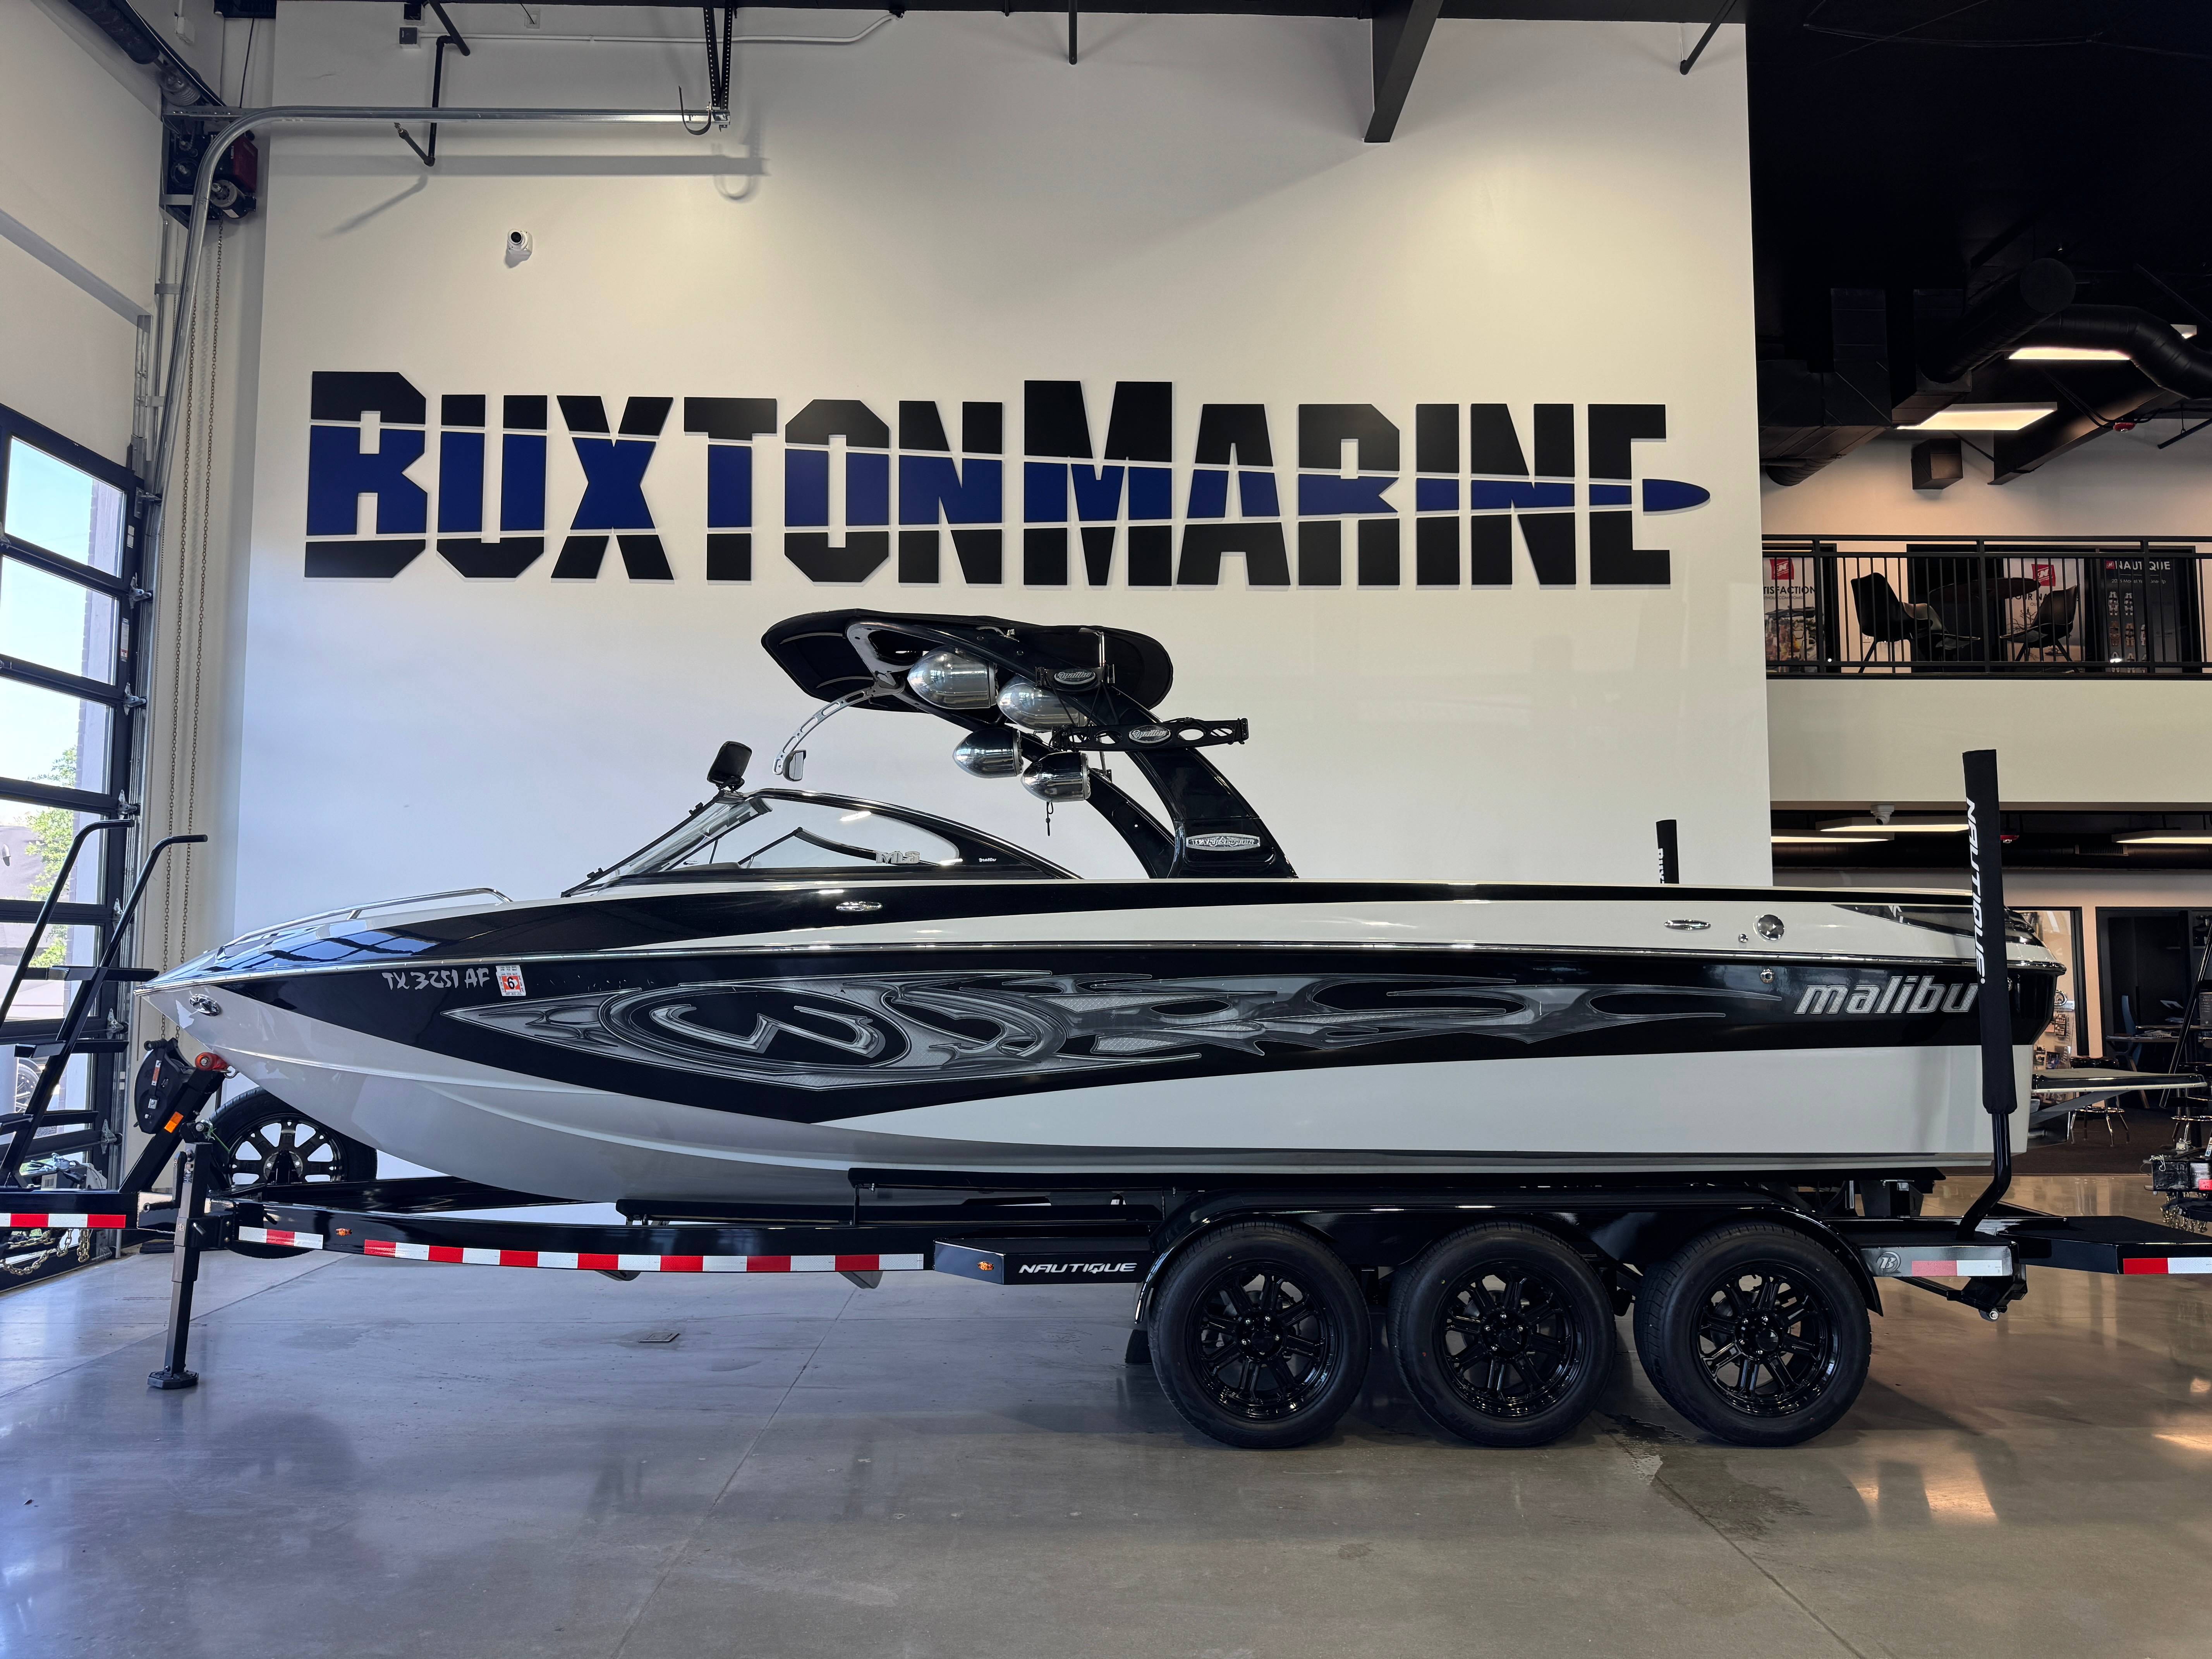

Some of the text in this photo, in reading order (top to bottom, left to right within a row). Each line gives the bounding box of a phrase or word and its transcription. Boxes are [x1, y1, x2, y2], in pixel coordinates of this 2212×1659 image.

[2115, 561, 2171, 570] NAUTQUE
[1966, 797, 1985, 977] NAUTIQUE
[381, 972, 410, 990] TX
[465, 968, 490, 989] AF
[507, 976, 515, 989] 6
[1794, 975, 1978, 1014] malibu
[1018, 1262, 1137, 1274] NAUTIQUE
